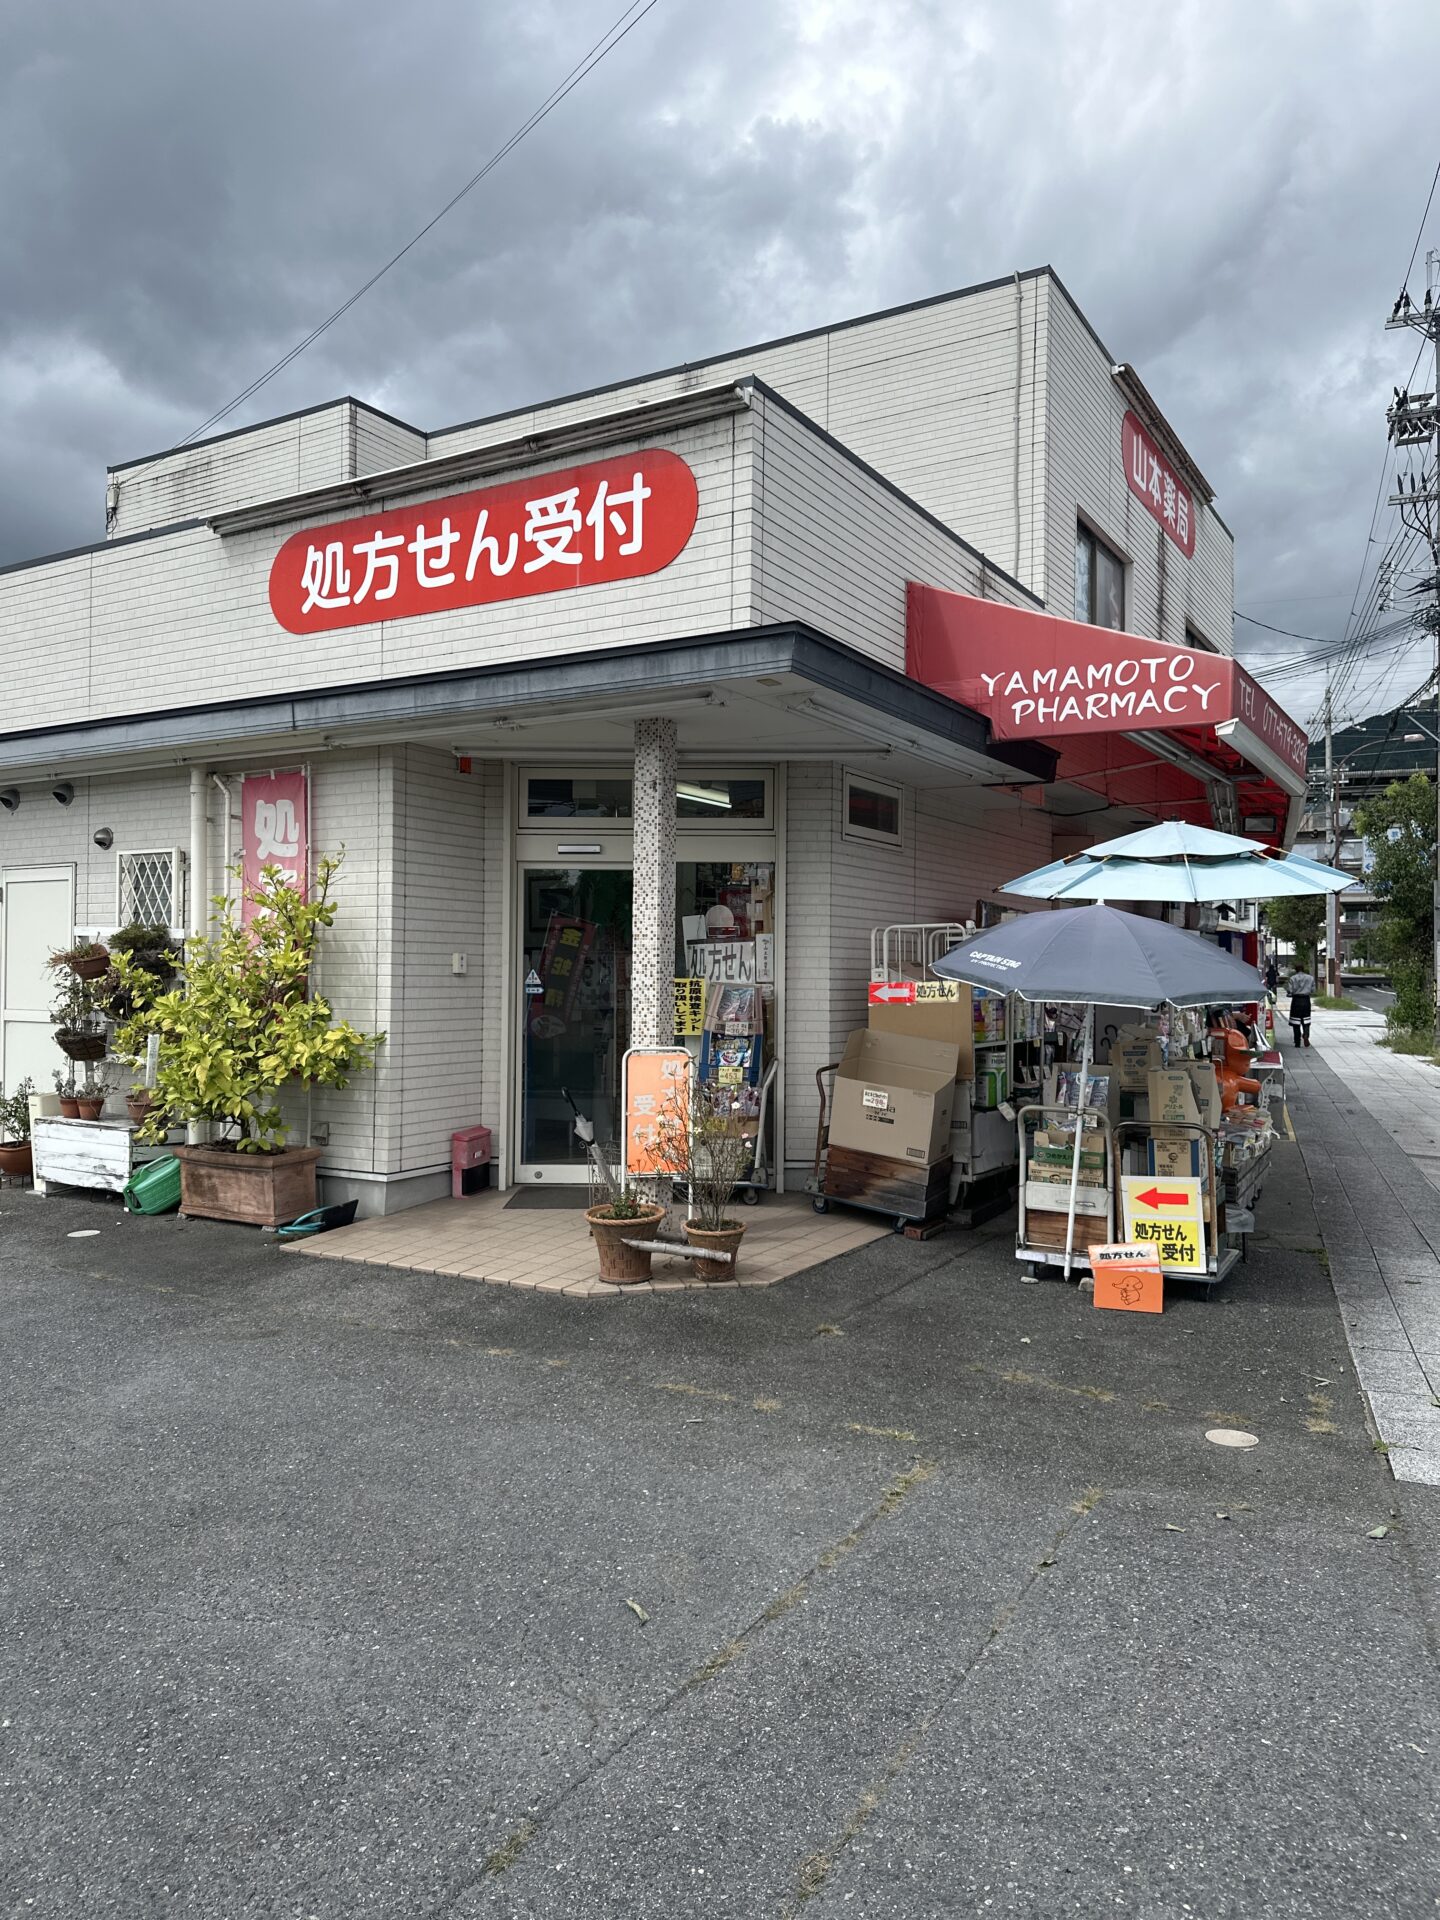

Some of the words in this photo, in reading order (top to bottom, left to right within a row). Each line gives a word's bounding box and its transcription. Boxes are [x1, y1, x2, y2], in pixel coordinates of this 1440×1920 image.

[1133, 434, 1188, 544] 山本薬局
[301, 472, 651, 614] 処方せん受付
[980, 655, 1195, 696] YAMAMOTO
[1011, 682, 1221, 725] PHARMACY
[1239, 677, 1256, 721] TEL
[690, 943, 753, 981] 処方せん
[689, 979, 702, 1032] 抗原検査キット
[916, 984, 955, 1000] 処方せん
[1134, 1221, 1188, 1241] 処方せん
[1099, 1249, 1147, 1260] 処方せん
[1161, 1243, 1196, 1262] 受付
